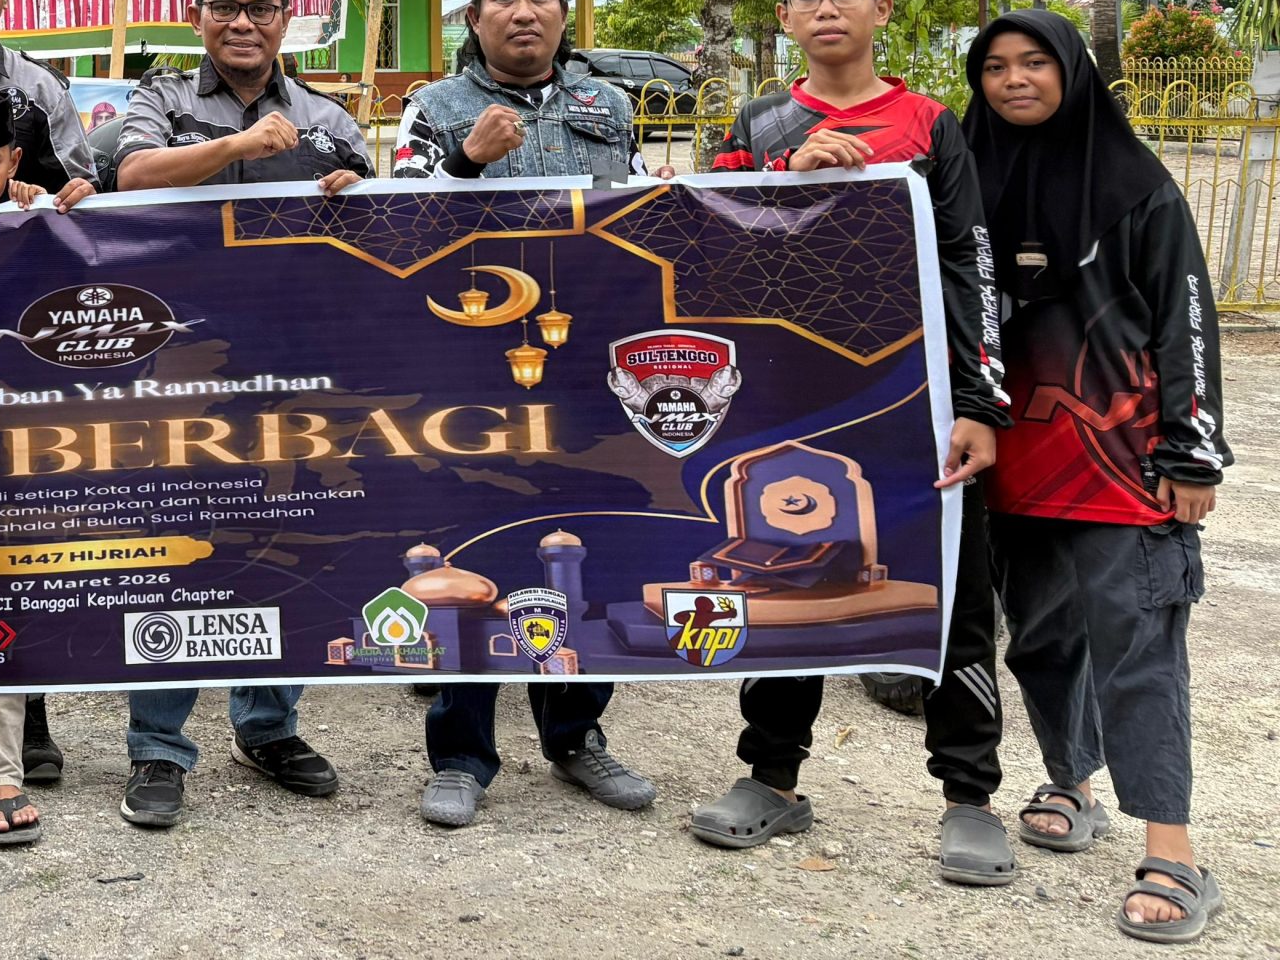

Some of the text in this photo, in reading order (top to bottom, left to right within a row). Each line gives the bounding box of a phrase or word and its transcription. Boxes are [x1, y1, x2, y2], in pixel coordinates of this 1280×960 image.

[972, 225, 995, 280] FOREVER
[1187, 275, 1203, 332] FOREVER
[48, 307, 143, 325] YAMAHA
[56, 338, 135, 353] CLUB
[58, 351, 136, 362] INDONESIA
[627, 350, 719, 366] SULTENGGO
[73, 383, 125, 401] Ya
[134, 374, 332, 398] Ramadhan
[657, 402, 697, 412] YAMAHA
[661, 423, 694, 431] CLUB
[3, 404, 558, 478] BERBAGI
[15, 488, 78, 505] setiap
[84, 484, 130, 497] Kota
[137, 481, 156, 493] di
[162, 478, 263, 492] Indonesia
[53, 498, 154, 516] harapkan
[160, 496, 201, 508] dan
[207, 493, 258, 506] kami
[264, 488, 365, 503] usahakan
[63, 517, 81, 530] di
[87, 513, 145, 529] Bulan
[150, 510, 194, 523] Suci
[200, 506, 315, 521] Ramadhan
[8, 546, 167, 566] 1447 HIJRIAH
[10, 573, 171, 592] 07 Maret 2026
[20, 594, 80, 612] Banggai
[87, 593, 164, 610] Kepulauan
[171, 588, 234, 604] Chapter
[509, 589, 565, 599] SULAWESI TENGAH
[188, 613, 268, 636] LENSA
[186, 637, 273, 658] BANGGAI
[520, 640, 537, 657] MOTOR
[544, 620, 565, 657] INDONESIA
